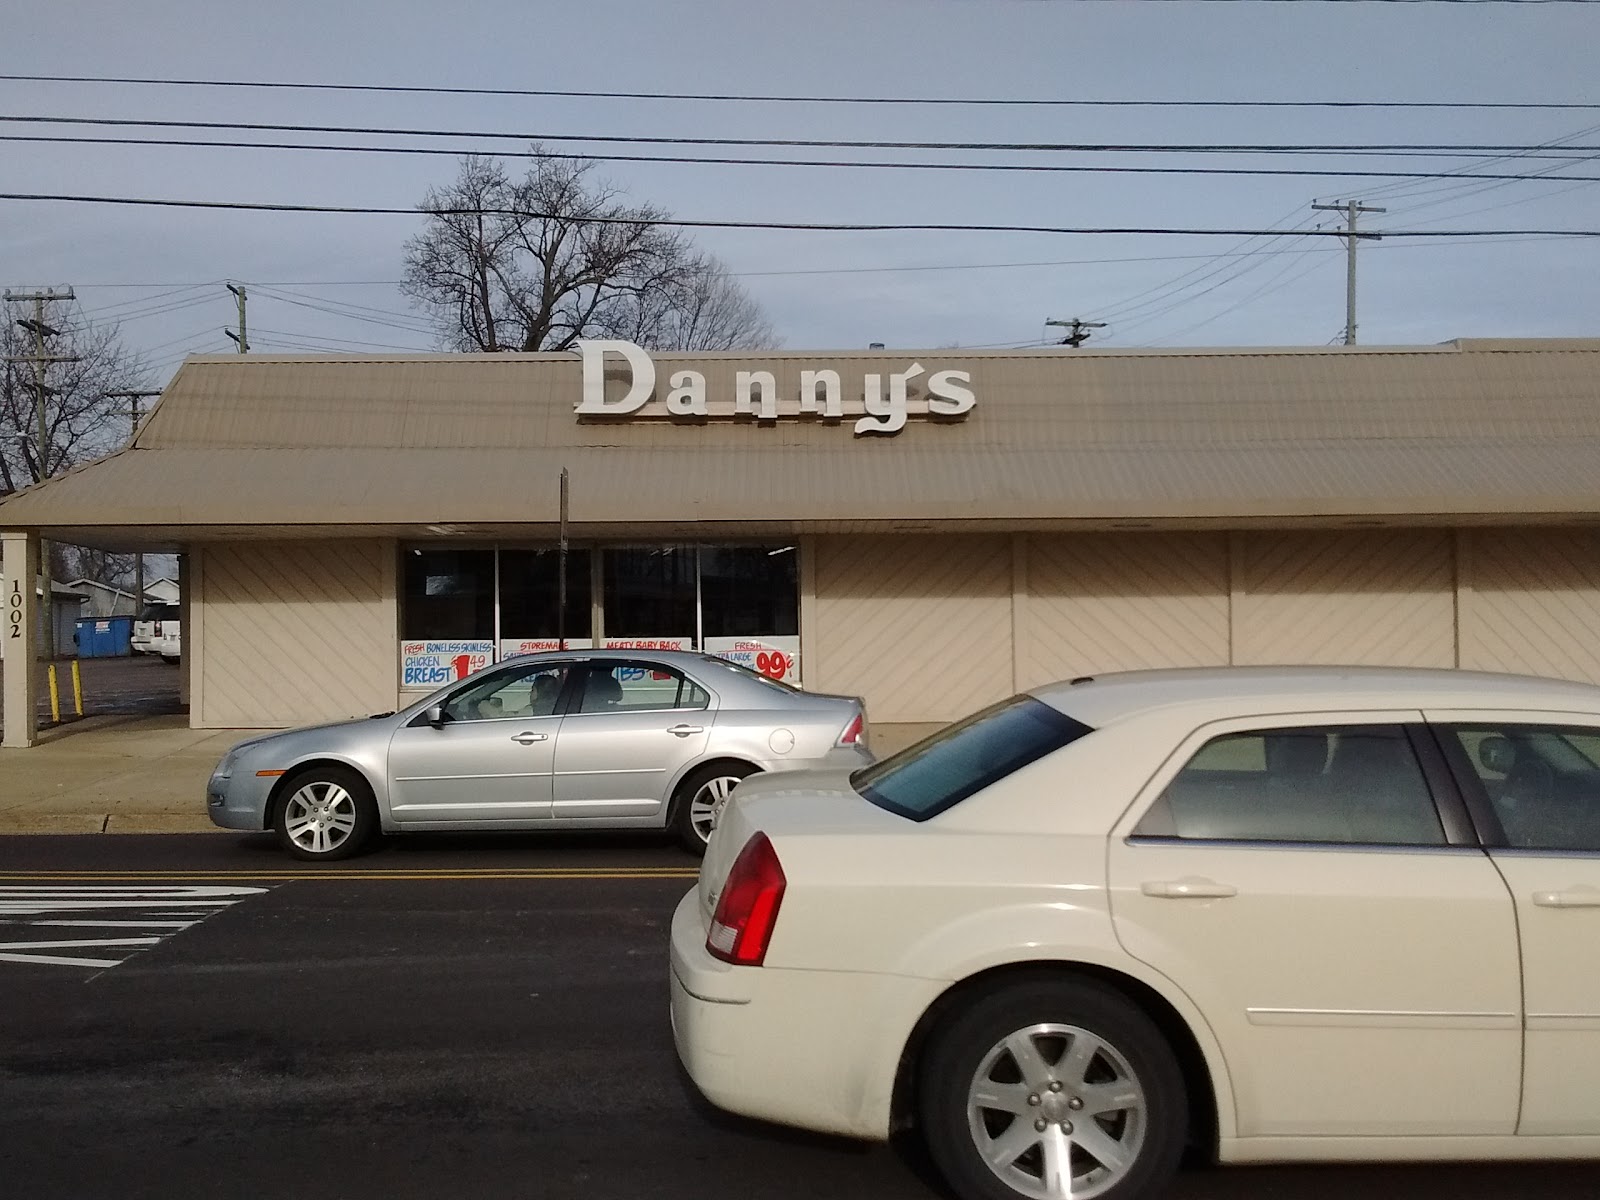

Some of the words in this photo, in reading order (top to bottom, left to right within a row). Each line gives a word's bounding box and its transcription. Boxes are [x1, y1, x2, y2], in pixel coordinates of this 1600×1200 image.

[573, 339, 977, 434] Danny's
[10, 579, 22, 638] 1002
[404, 643, 425, 655] FRESH
[426, 642, 460, 654] BONELESS
[461, 642, 492, 653] SKINLESS
[520, 641, 569, 651] STOREMAE
[606, 641, 634, 650] MEATY
[636, 641, 658, 651] BABY
[659, 641, 682, 651] BACK
[734, 641, 762, 650] FRESH
[405, 655, 440, 667] CHICKEN
[731, 652, 752, 662] LARGE
[404, 667, 453, 684] BREAST
